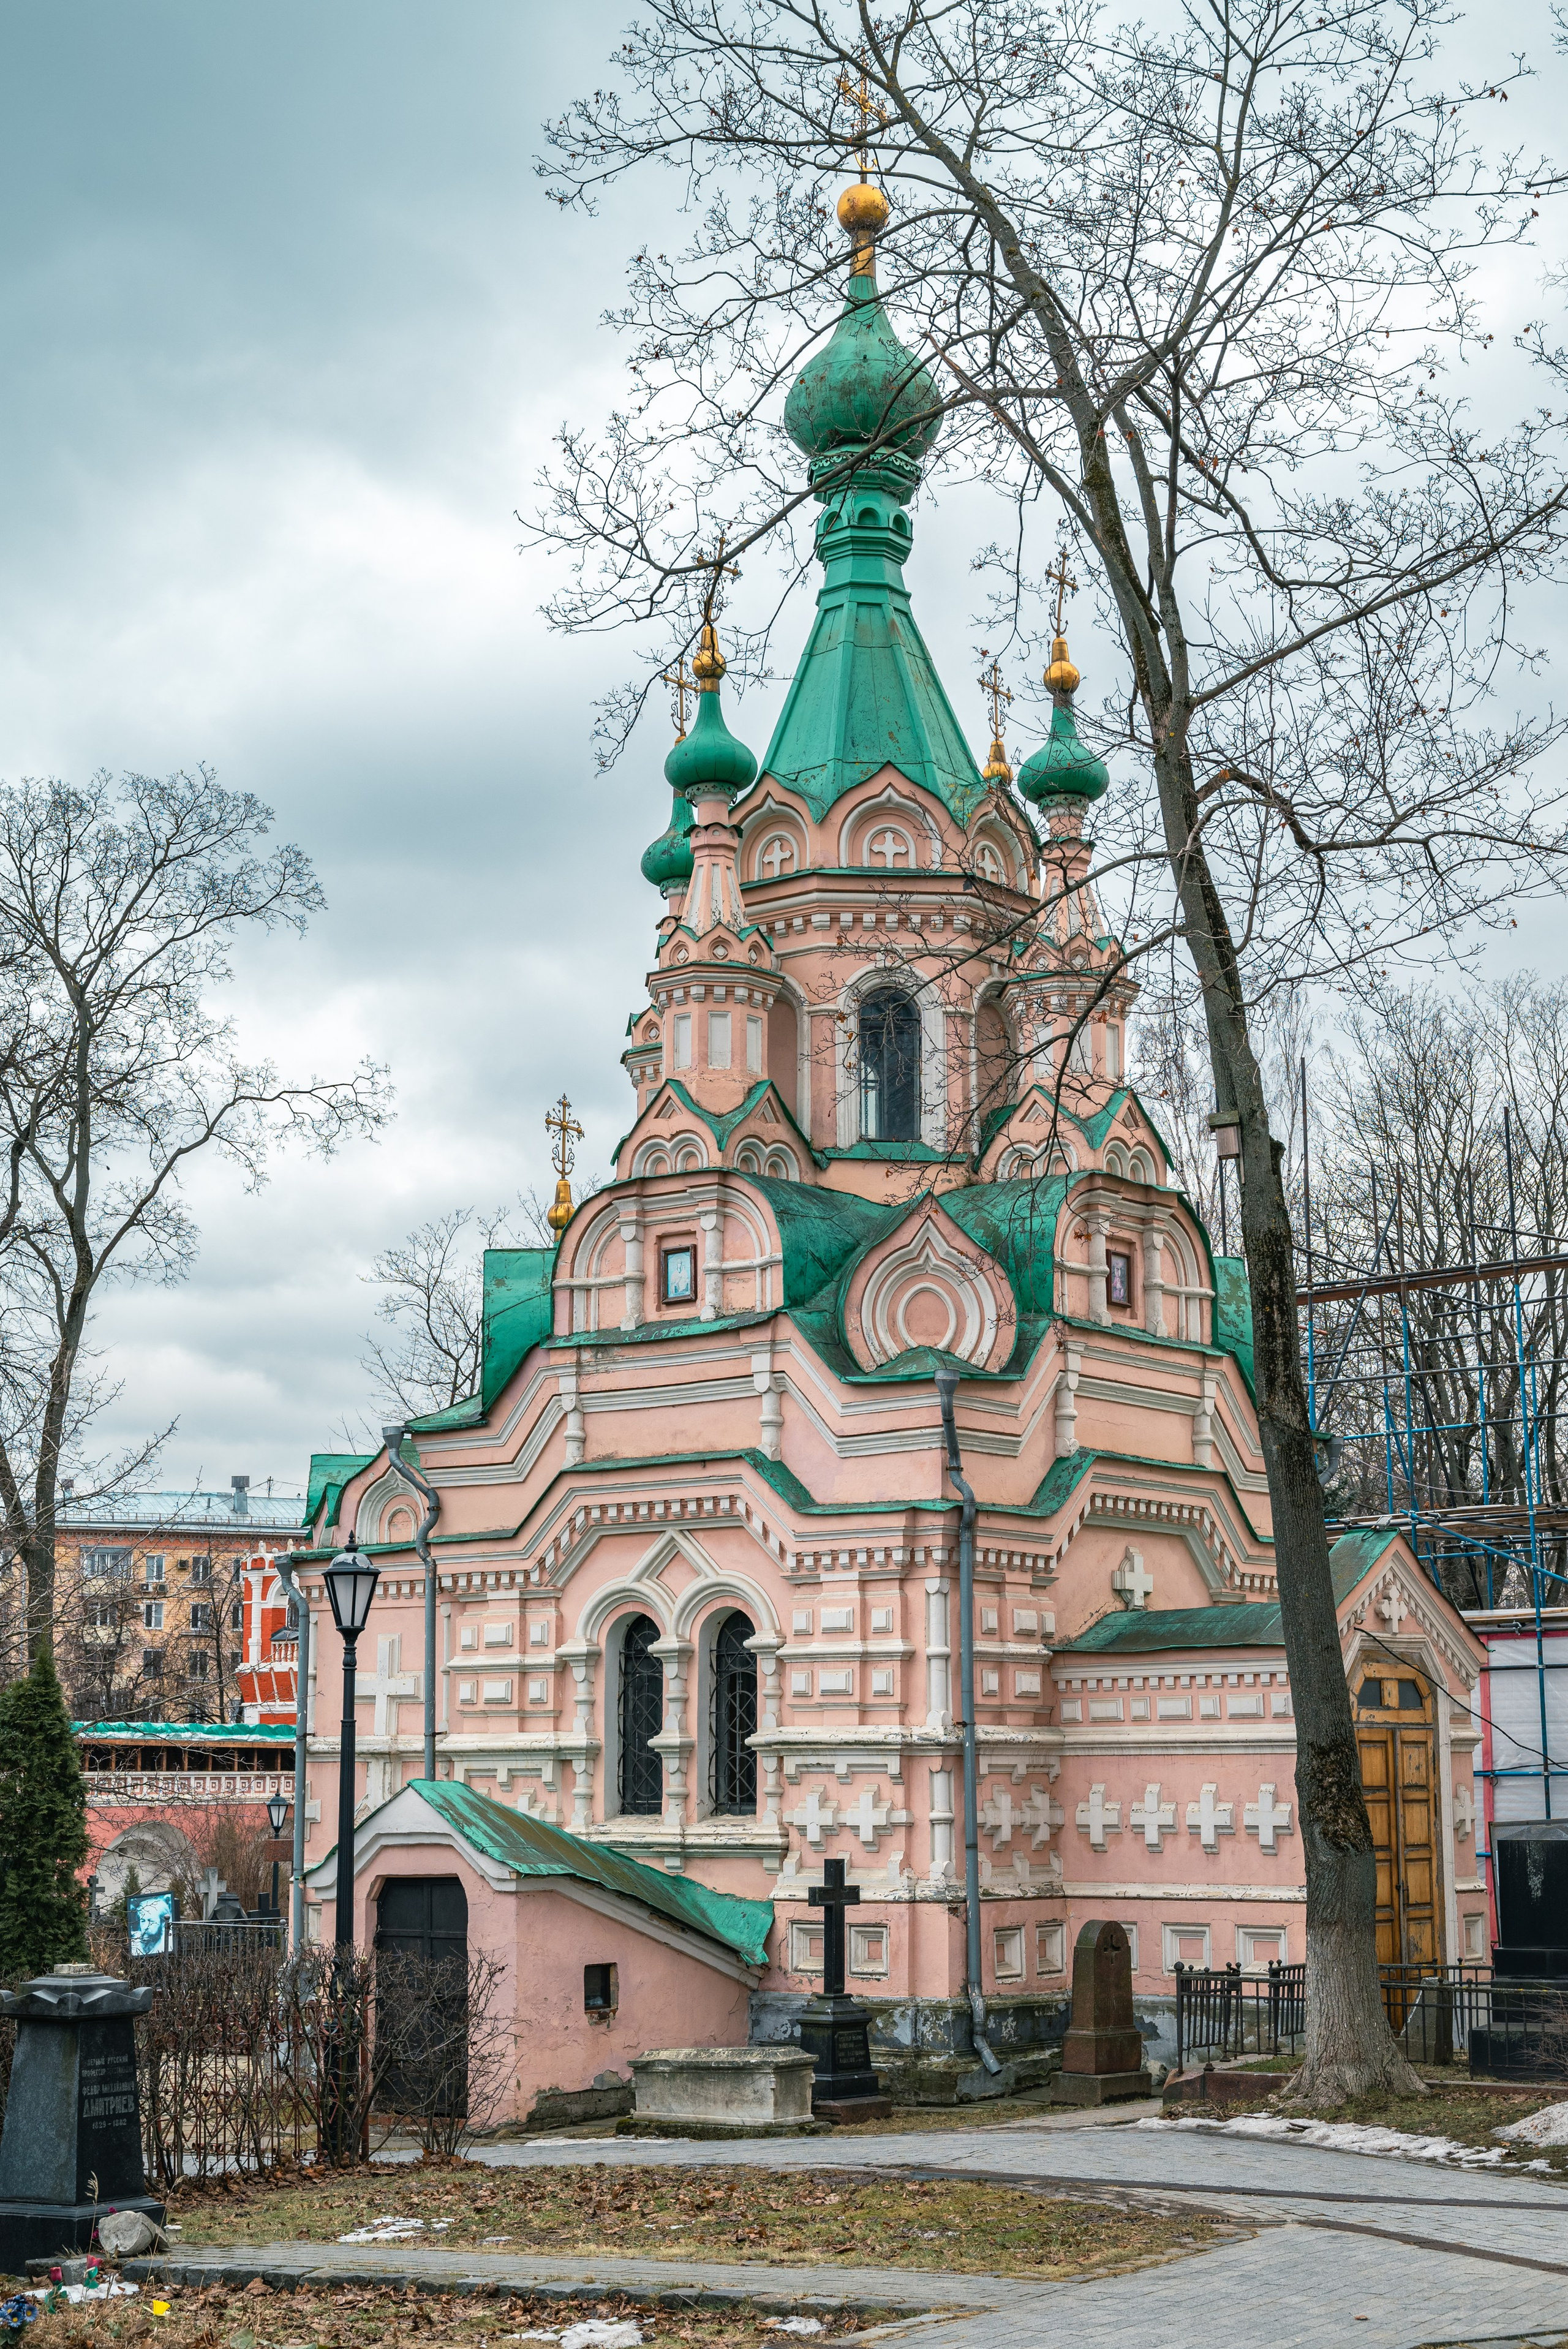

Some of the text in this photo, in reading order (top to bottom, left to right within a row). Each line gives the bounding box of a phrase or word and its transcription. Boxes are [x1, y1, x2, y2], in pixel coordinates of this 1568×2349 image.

[82, 2085, 100, 2095] ФЕДОР
[83, 2095, 135, 2117] ДМИТРИЕВ
[92, 2121, 107, 2129] 1829
[113, 2118, 127, 2127] 1882
